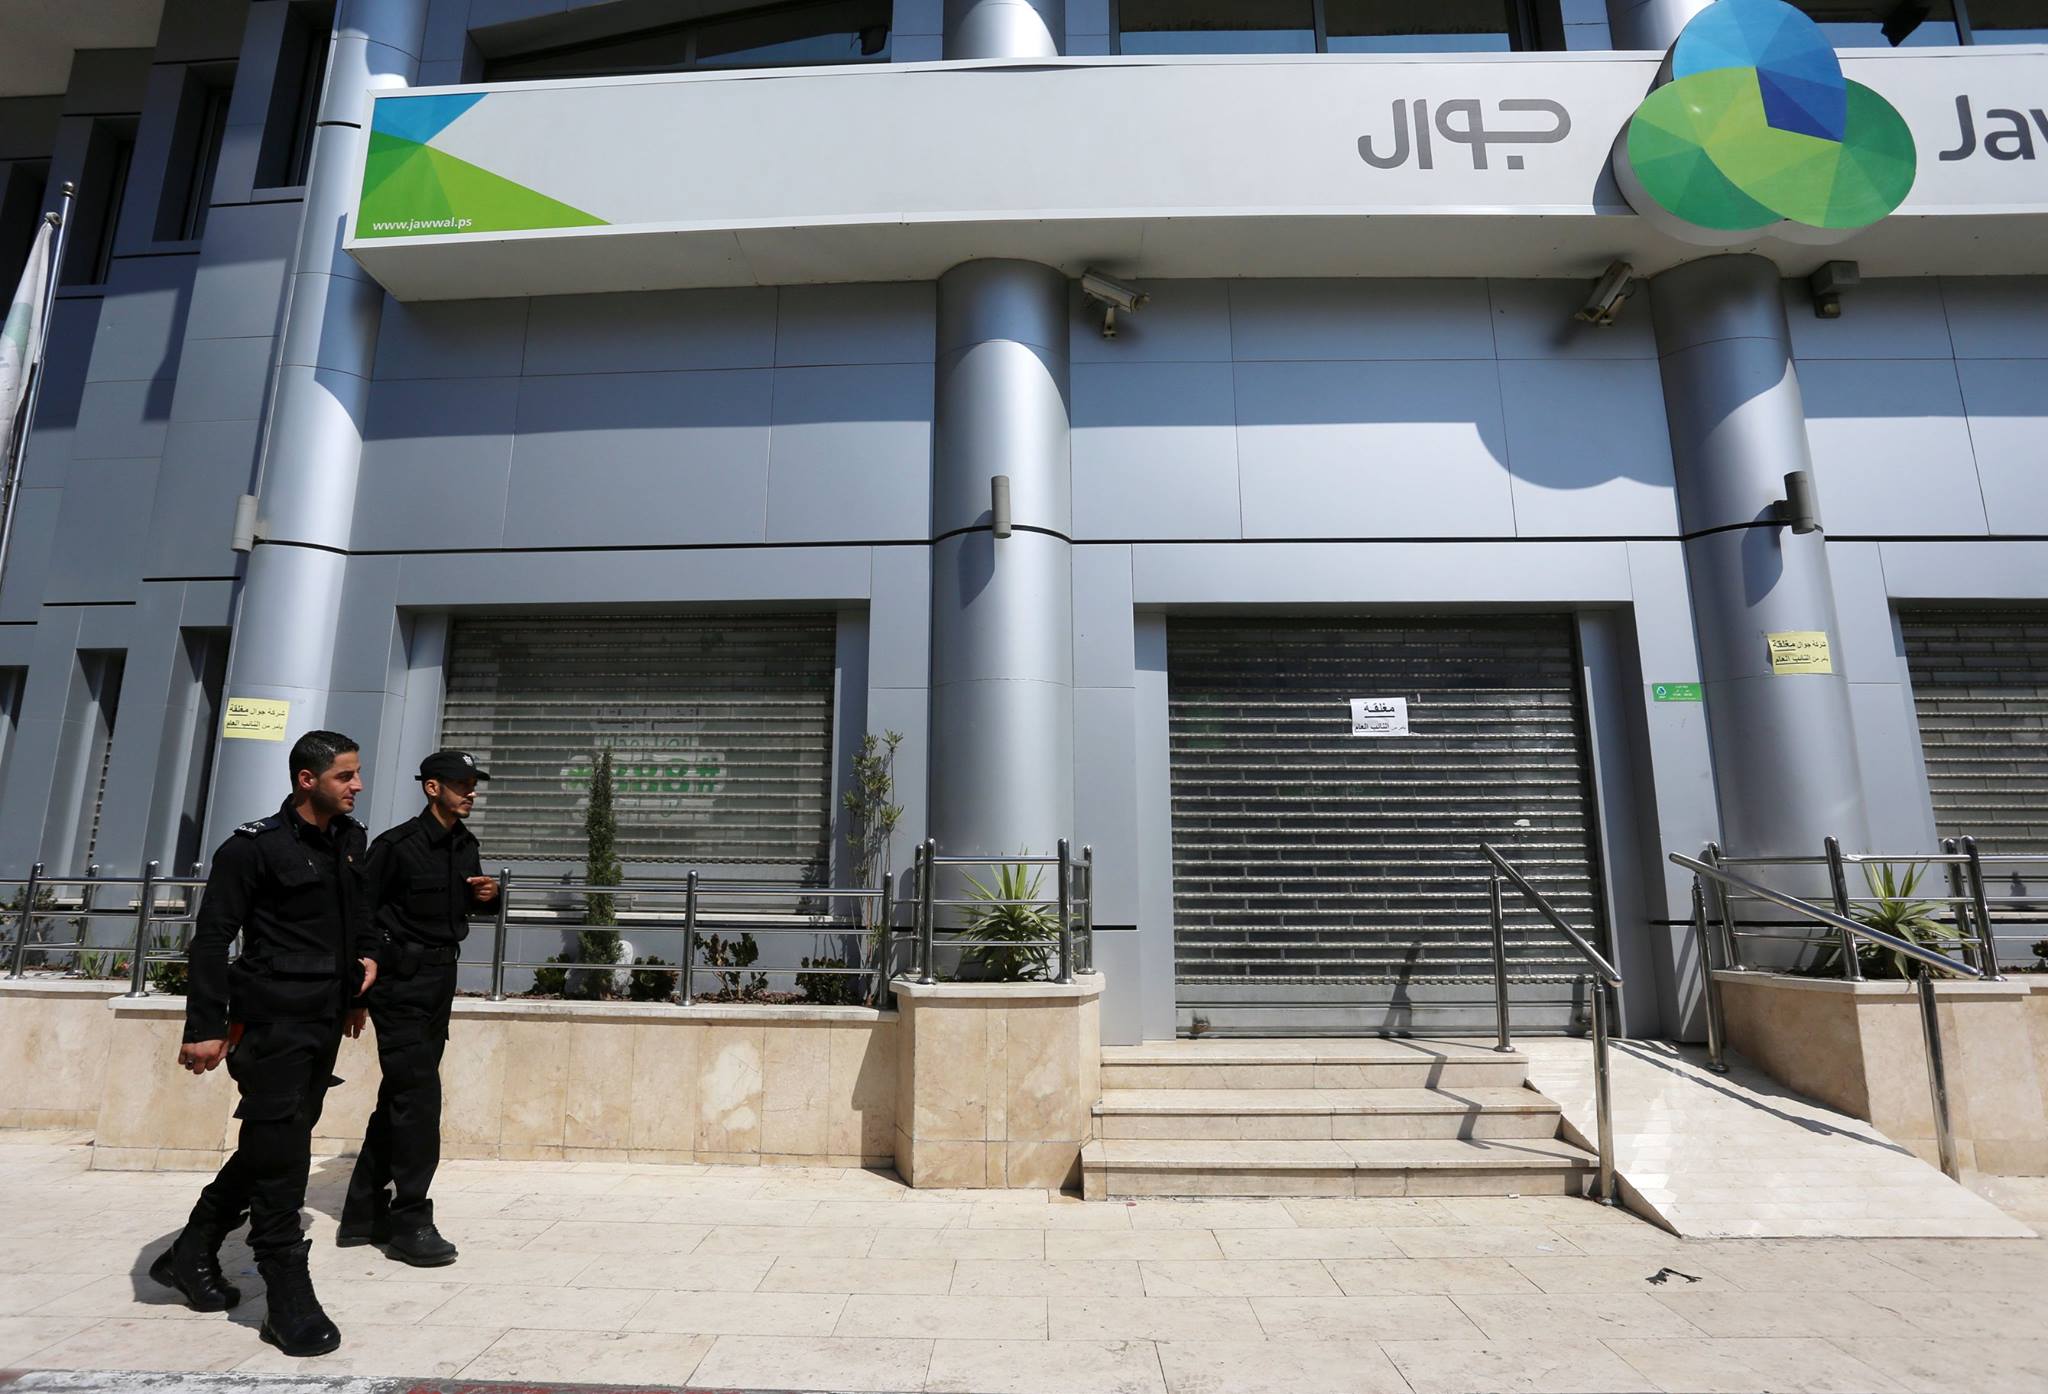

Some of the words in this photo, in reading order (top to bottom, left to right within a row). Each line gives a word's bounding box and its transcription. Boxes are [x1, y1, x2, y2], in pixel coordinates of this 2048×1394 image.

[1357, 99, 1571, 170] جوال
[372, 217, 472, 232] www.jawwal.ps
[1772, 639, 1796, 648] مغلقة
[229, 703, 249, 713] مغلقة
[1363, 701, 1395, 713] مغلقة
